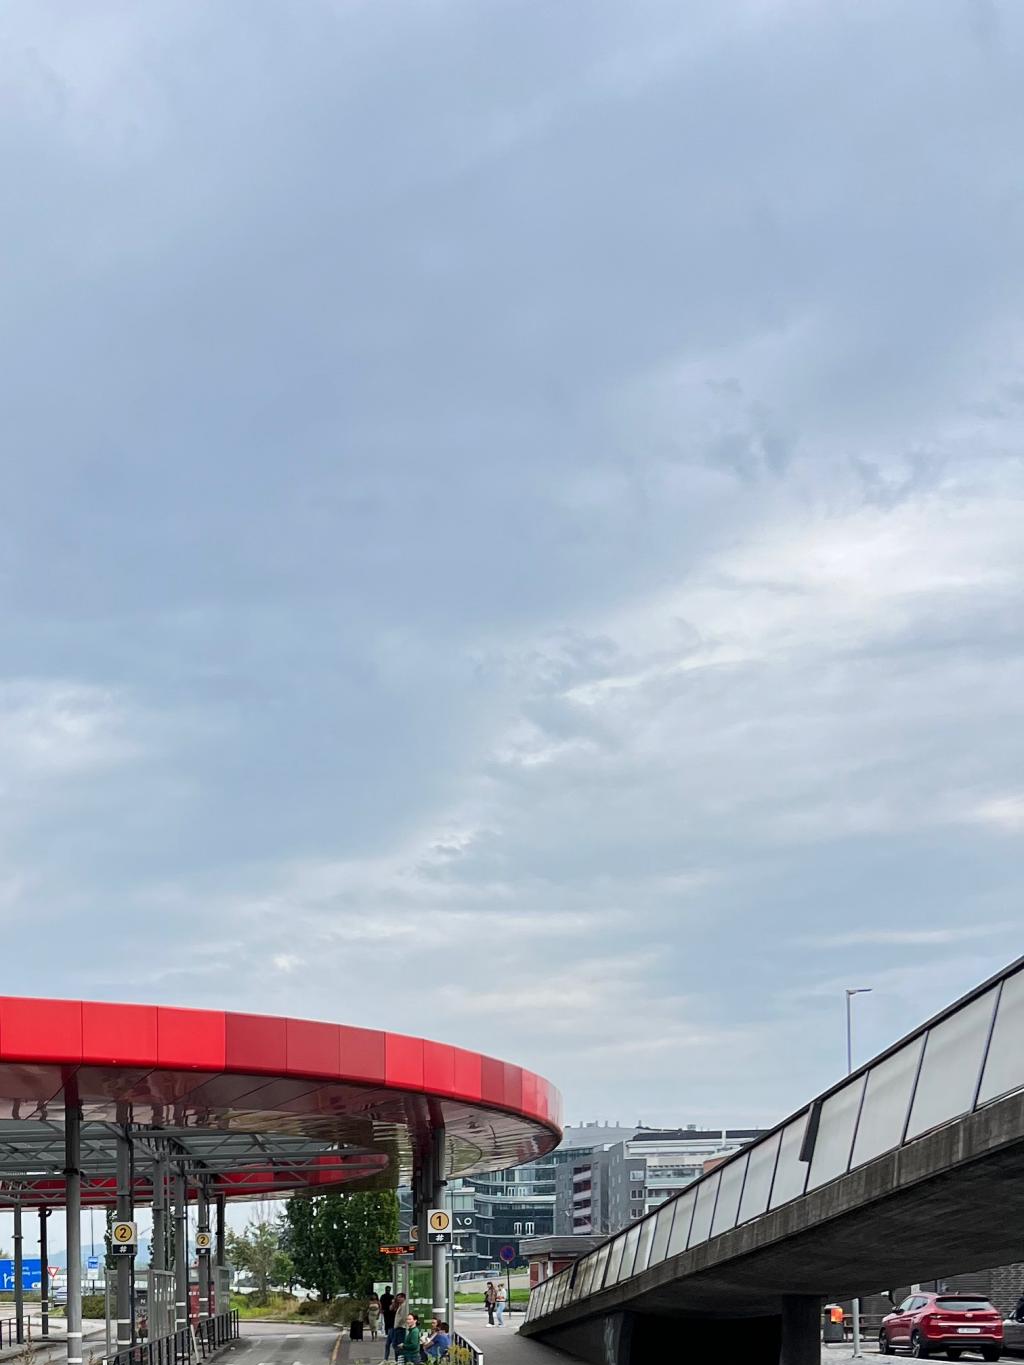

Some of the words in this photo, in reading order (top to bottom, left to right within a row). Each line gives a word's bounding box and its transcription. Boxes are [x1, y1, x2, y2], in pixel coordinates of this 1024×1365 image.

[436, 1215, 442, 1226] 1
[119, 1227, 127, 1239] 2
[200, 1236, 206, 1244] 2
